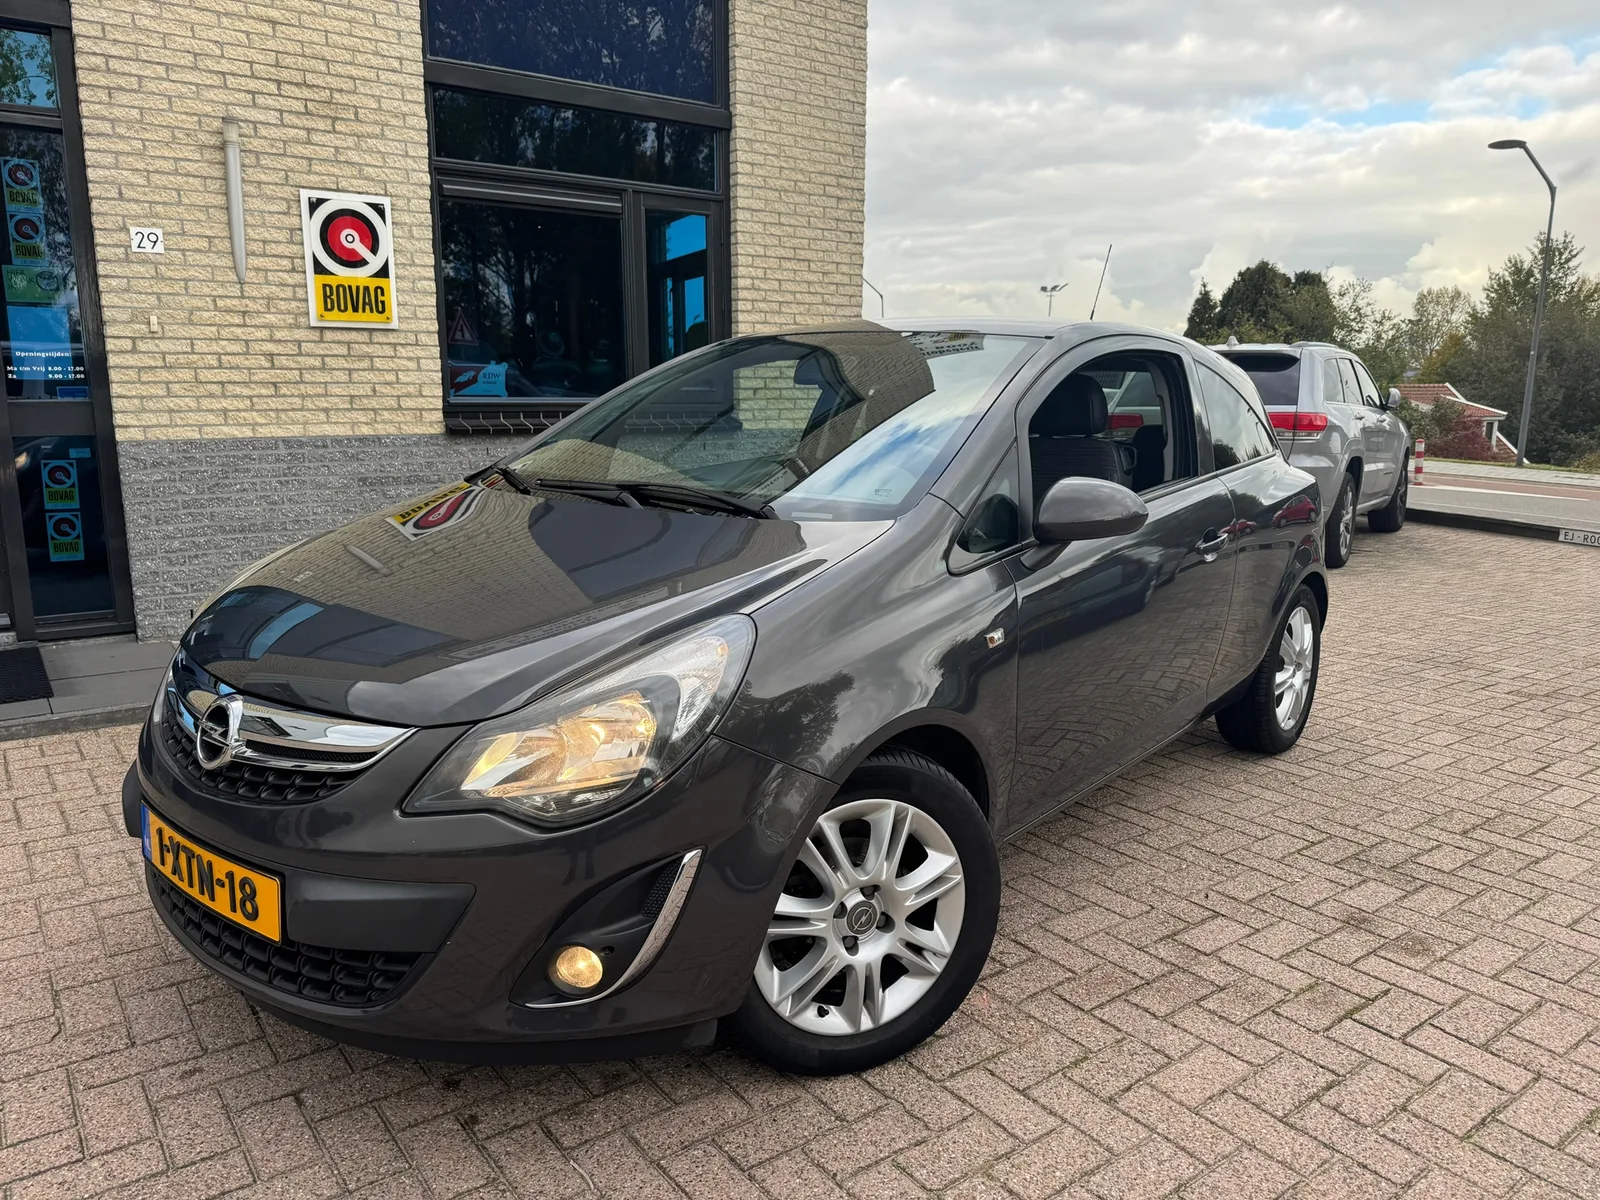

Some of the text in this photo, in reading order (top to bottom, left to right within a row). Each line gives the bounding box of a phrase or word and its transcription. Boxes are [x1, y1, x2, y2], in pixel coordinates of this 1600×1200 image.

[9, 190, 38, 204] BOVAG
[134, 230, 160, 249] 29
[321, 282, 387, 315] BOVAG
[48, 490, 75, 501] BOVAG
[53, 541, 79, 553] BOVAG
[156, 826, 259, 922] 1-XTN-18
